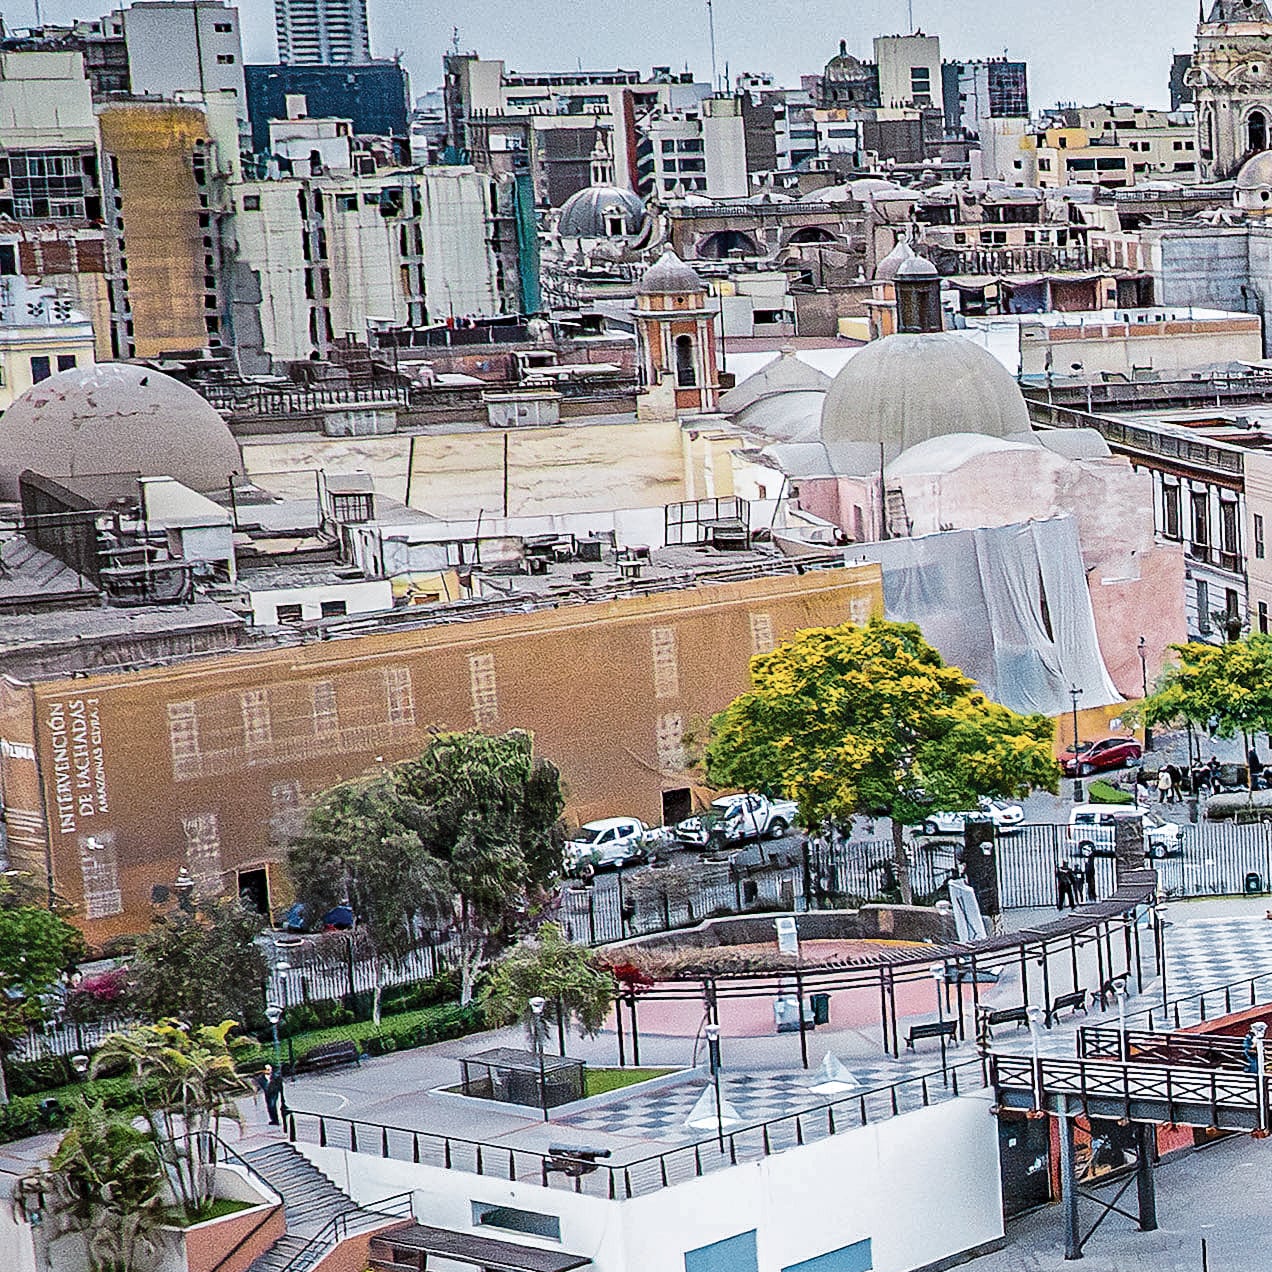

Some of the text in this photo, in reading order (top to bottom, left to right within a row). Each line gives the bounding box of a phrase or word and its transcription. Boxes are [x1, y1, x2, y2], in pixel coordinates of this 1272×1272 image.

[46, 703, 76, 834] INTERVENCIÓN
[69, 700, 94, 817] DE FACHADAS
